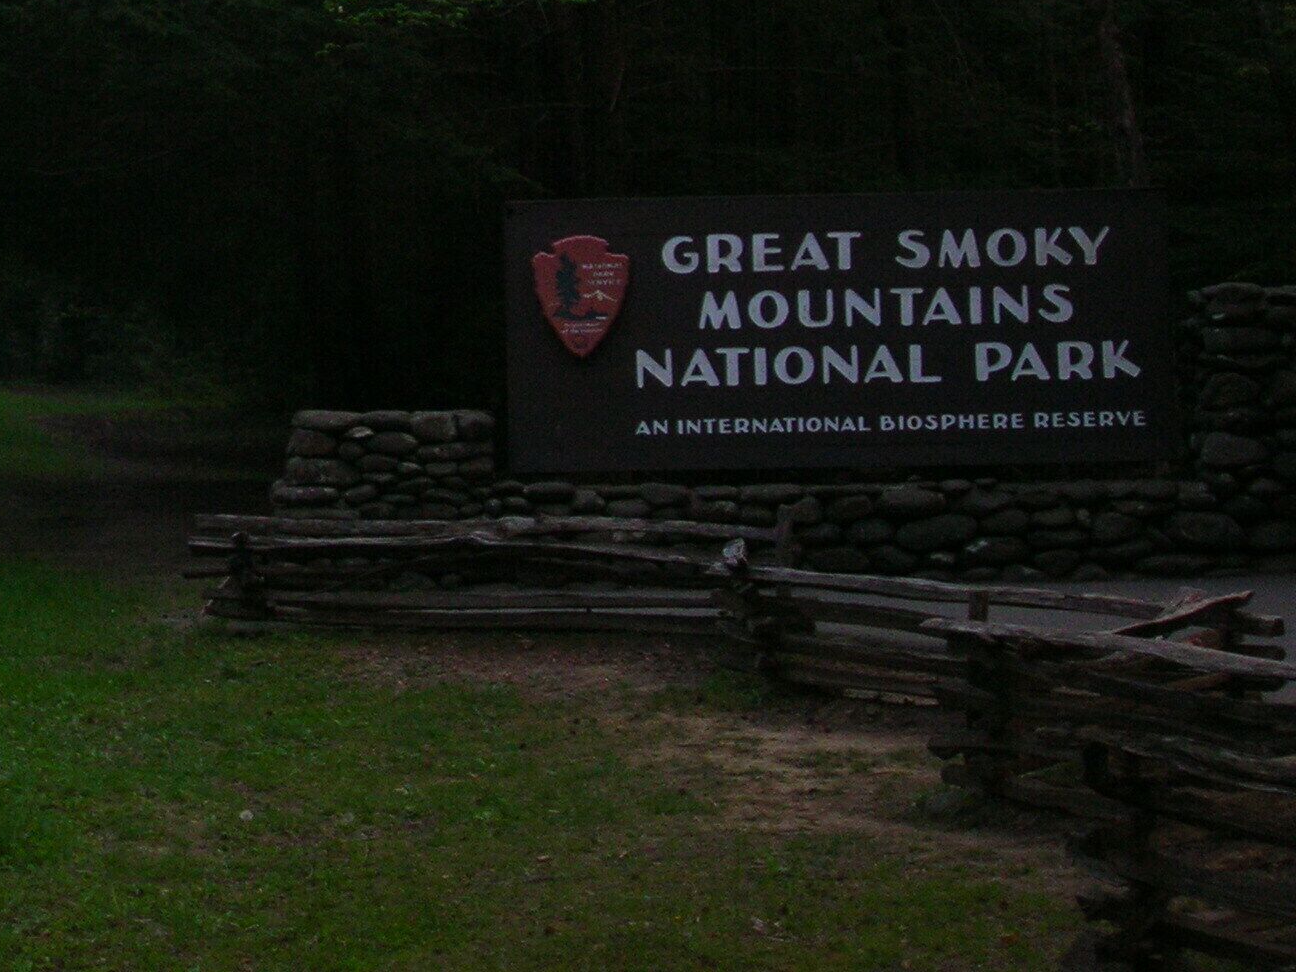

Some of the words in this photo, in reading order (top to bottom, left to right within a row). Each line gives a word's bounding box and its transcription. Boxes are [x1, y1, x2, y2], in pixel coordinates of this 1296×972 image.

[661, 231, 861, 274] GREAT
[895, 227, 1109, 269] SMOKY
[699, 284, 1073, 330] MOUNTAINS
[636, 342, 942, 389] NATIONAL
[975, 340, 1141, 382] PARK
[636, 420, 668, 435] AN
[677, 416, 871, 435] INTERNATIONAL
[880, 414, 1022, 431] BIOSPHERE
[1034, 411, 1146, 428] RESERVE
